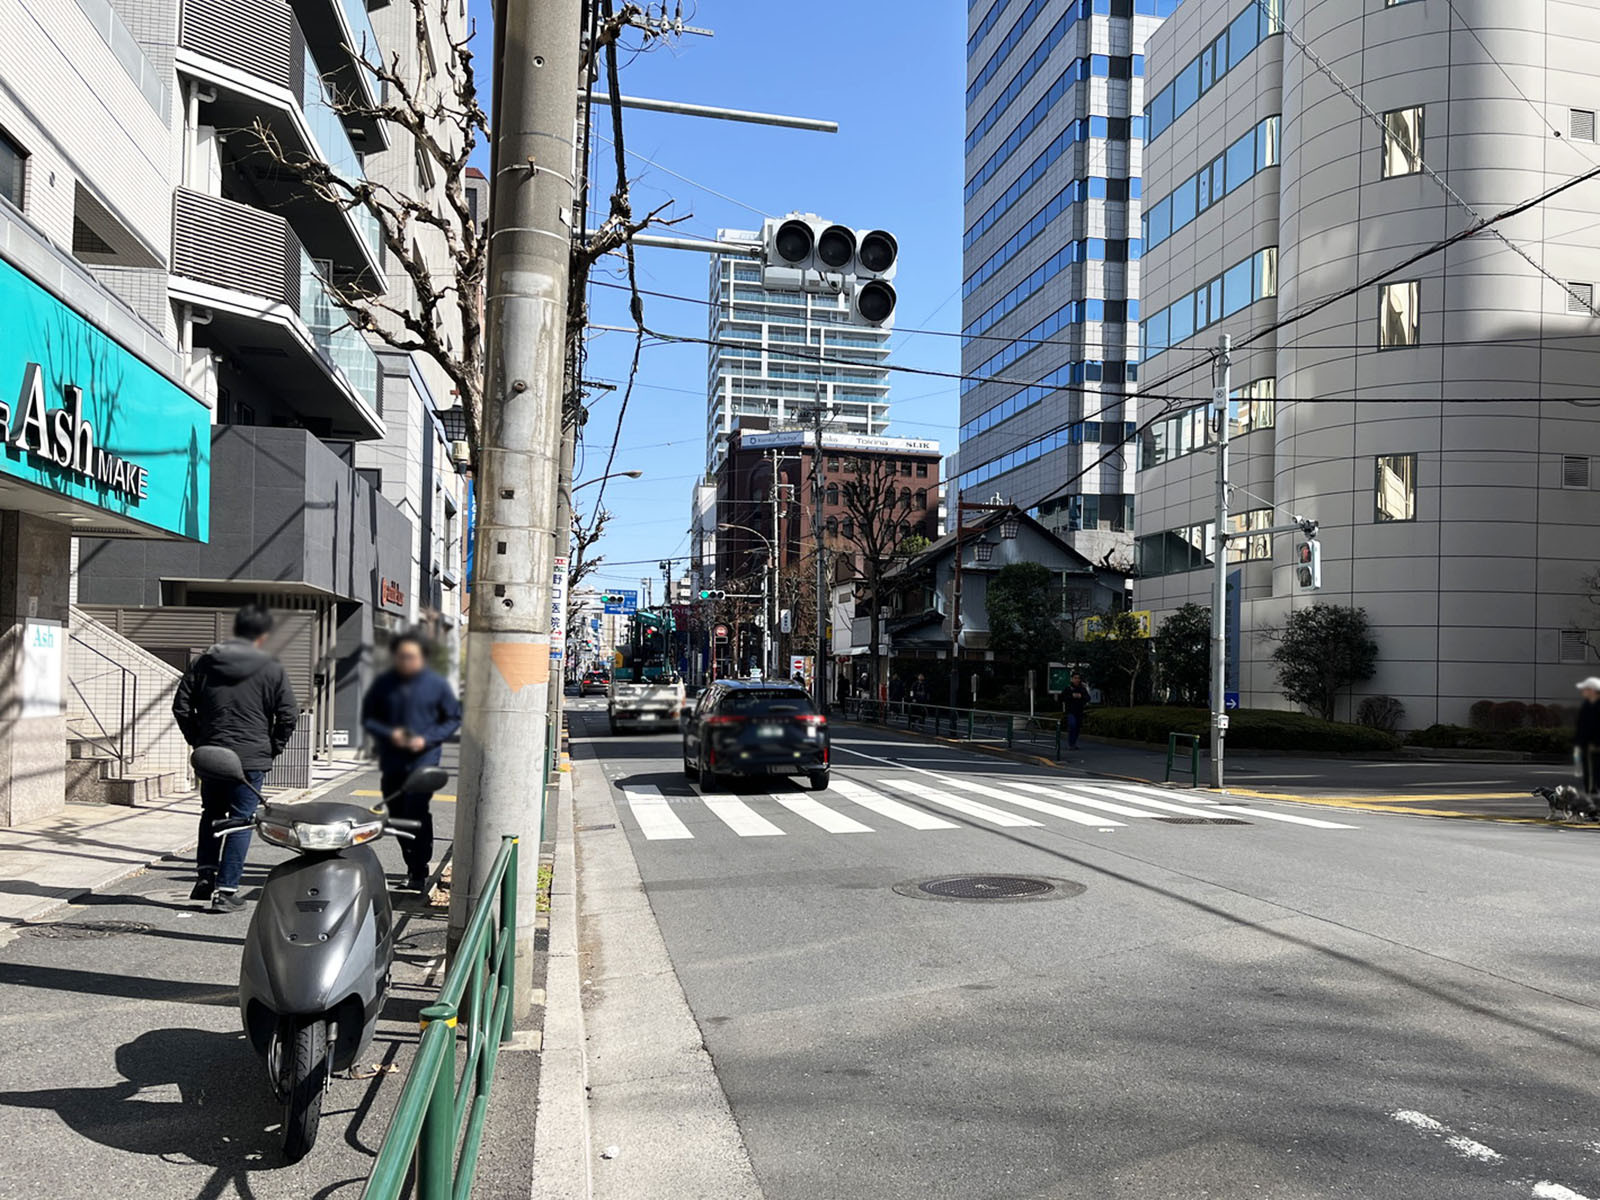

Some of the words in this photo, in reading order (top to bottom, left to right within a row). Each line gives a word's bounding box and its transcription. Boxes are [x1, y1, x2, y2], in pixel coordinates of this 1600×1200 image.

[14, 363, 95, 477] Ash
[98, 449, 149, 500] MAKE
[551, 574, 562, 627] 野口医院
[32, 624, 54, 648] Ash
